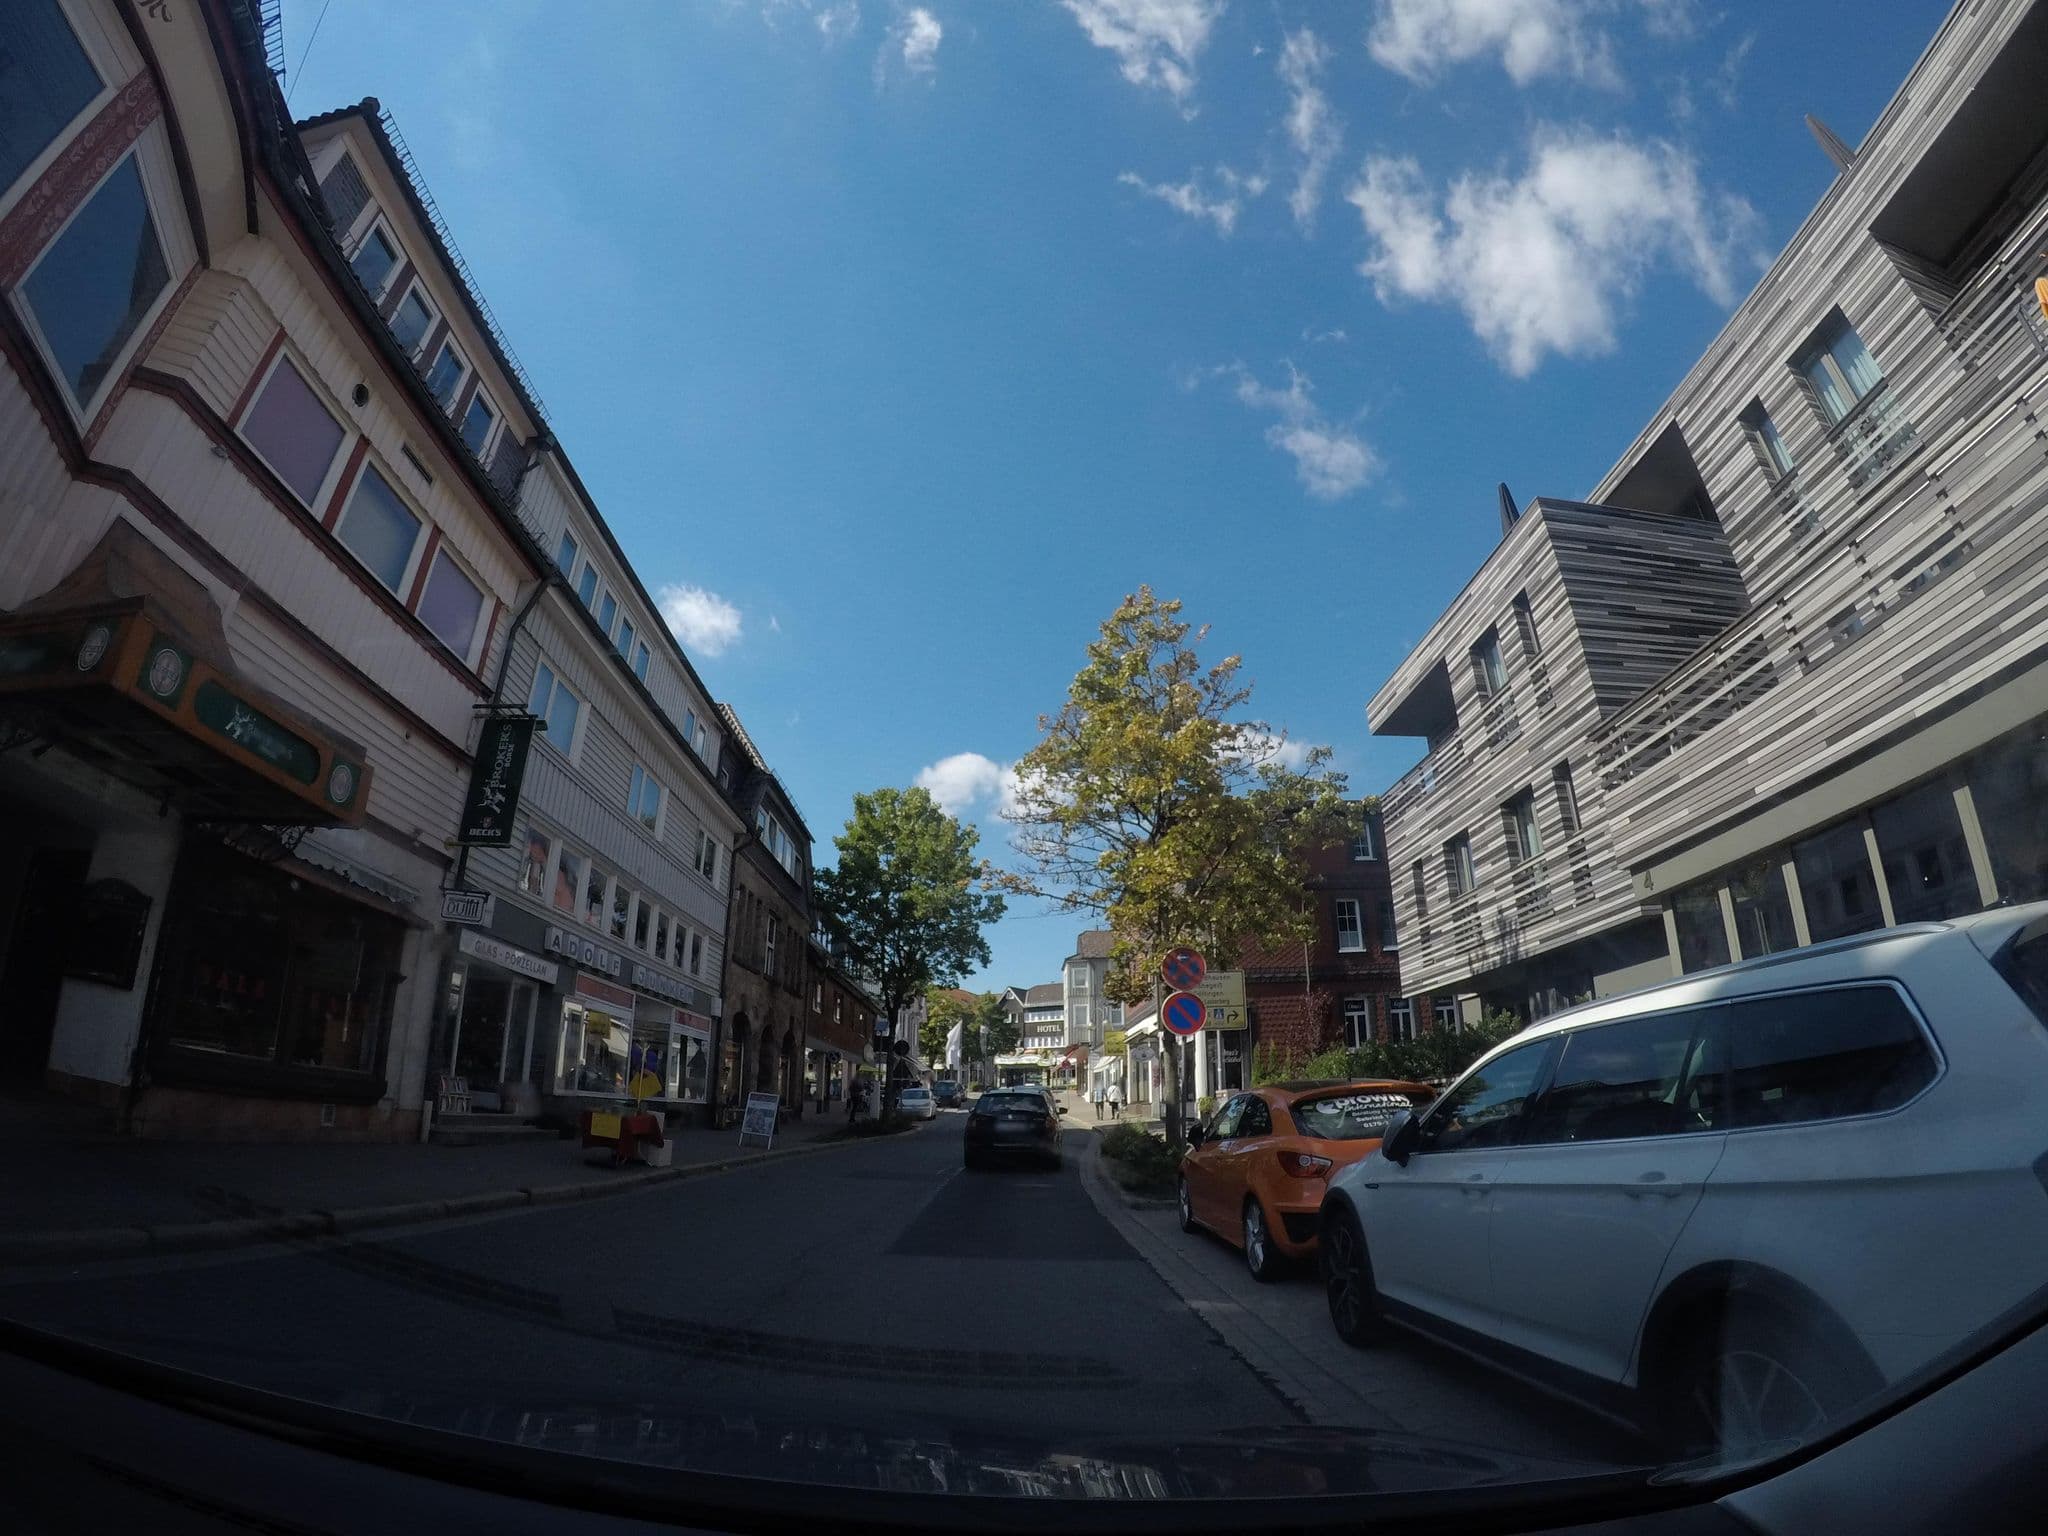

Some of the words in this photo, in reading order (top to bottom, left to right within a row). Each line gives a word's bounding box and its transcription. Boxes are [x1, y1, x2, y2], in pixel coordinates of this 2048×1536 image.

[1644, 870, 1654, 891] 4
[474, 940, 498, 959] GLAS
[504, 951, 548, 977] PORZELLAN
[551, 934, 621, 973] ADOLF
[1036, 1024, 1062, 1033] HOTEL
